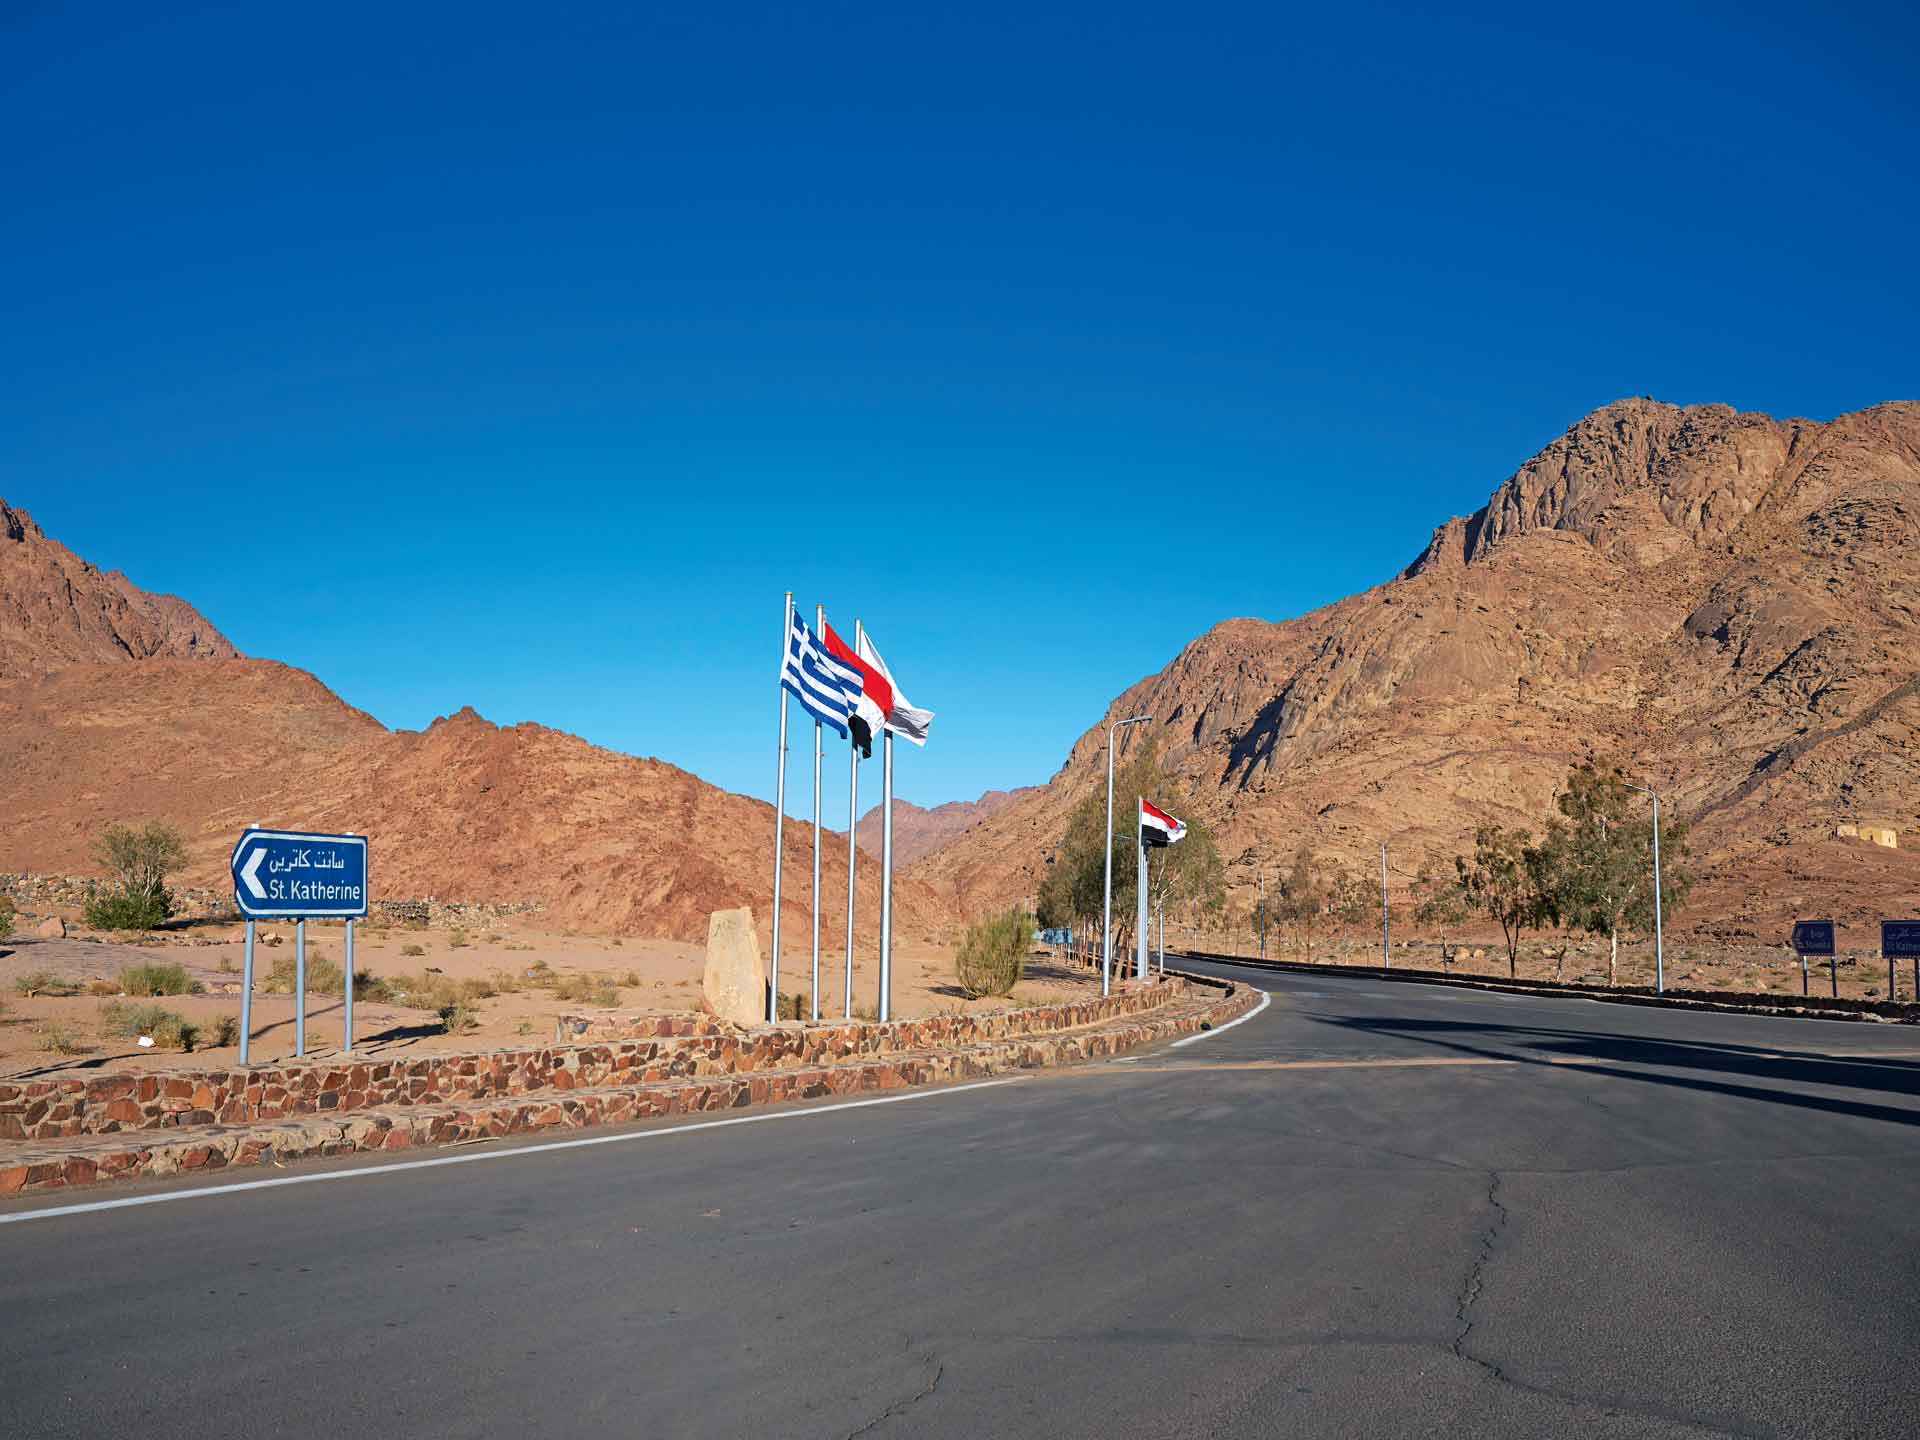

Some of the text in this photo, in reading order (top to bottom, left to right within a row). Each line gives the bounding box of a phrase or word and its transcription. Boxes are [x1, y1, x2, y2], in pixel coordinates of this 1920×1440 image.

[269, 848, 345, 873] سانت كاترين
[269, 879, 360, 900] St. Katherine
